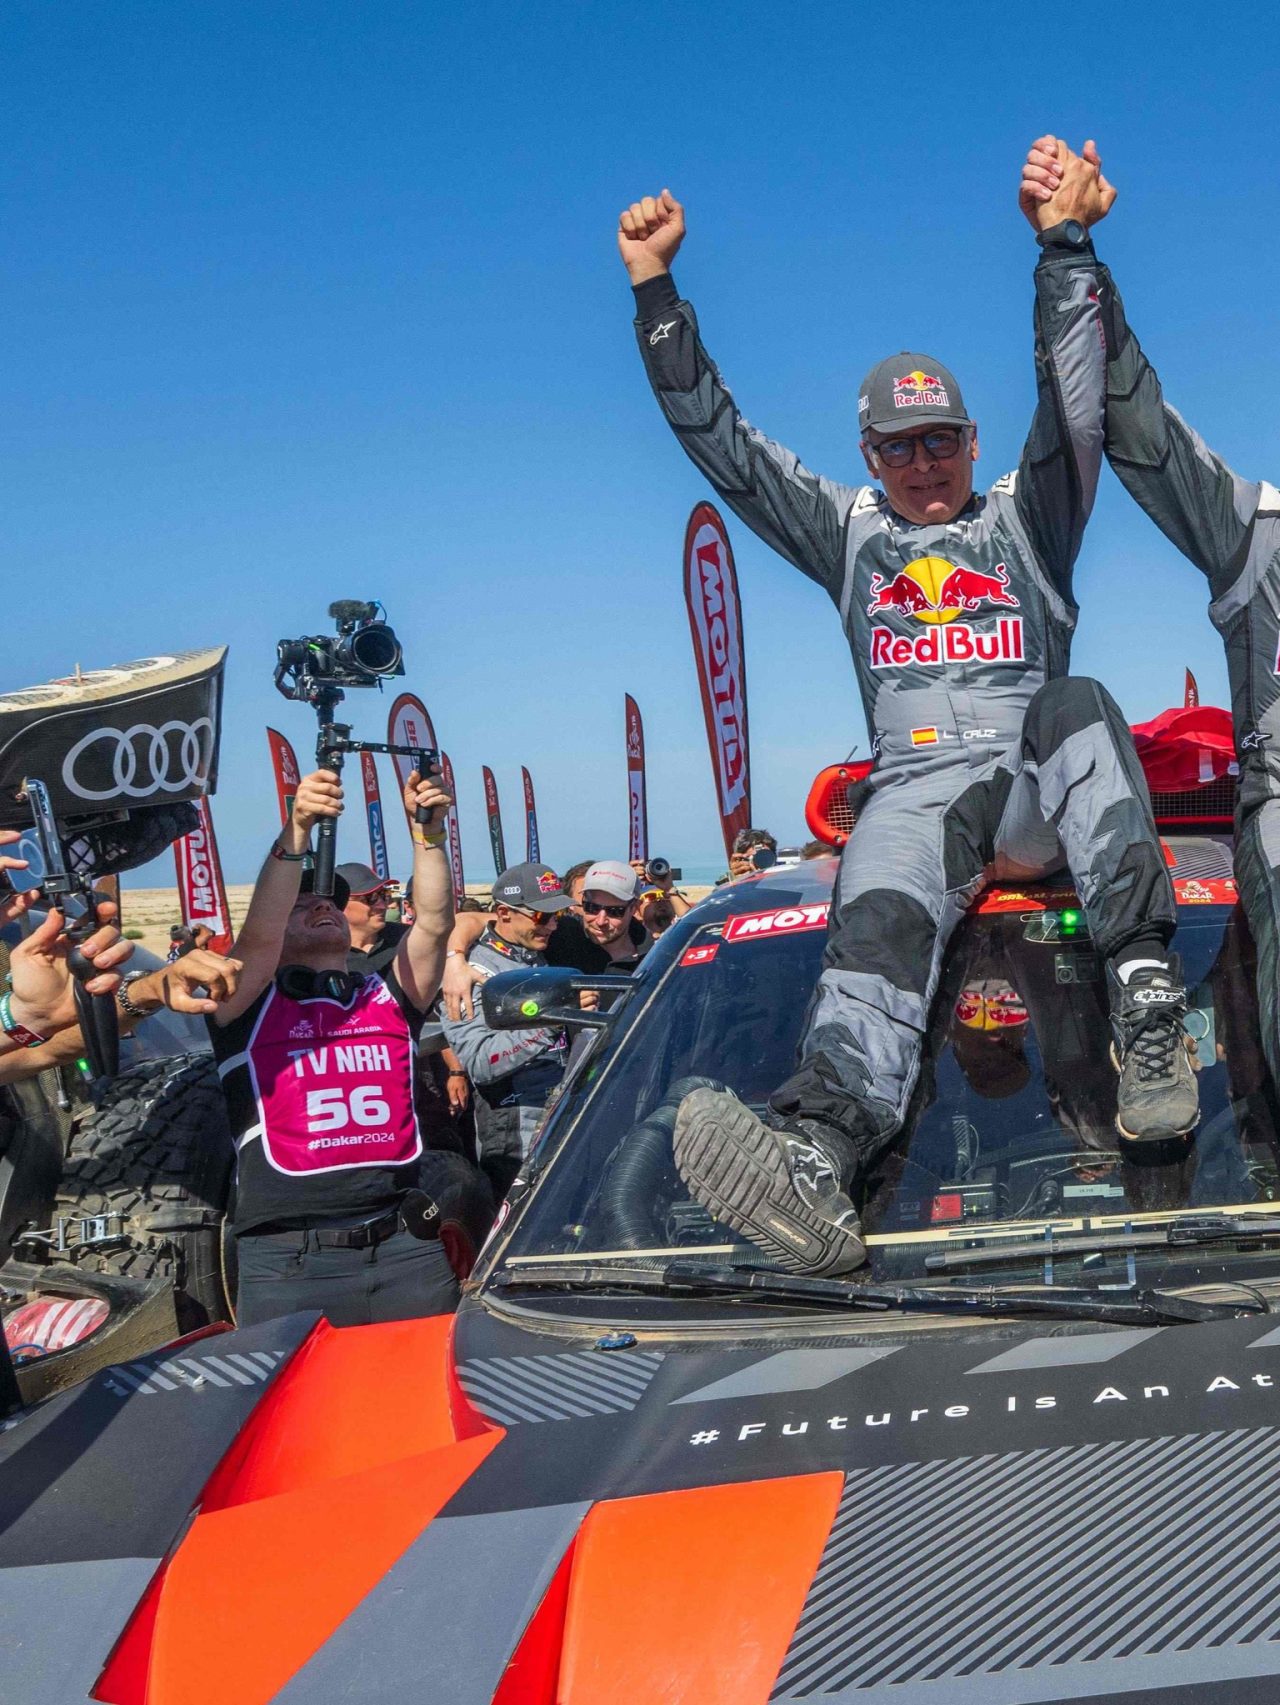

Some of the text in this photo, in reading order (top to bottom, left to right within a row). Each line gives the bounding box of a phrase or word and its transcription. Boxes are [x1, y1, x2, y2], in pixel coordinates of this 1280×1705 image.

[893, 391, 949, 408] Red Bull
[870, 617, 1025, 669] Red Bull
[700, 559, 739, 777] MOTUL
[943, 729, 997, 740] L CRUZ
[189, 822, 214, 913] MOTU
[735, 904, 832, 936] MOT
[287, 1044, 393, 1078] TV NRH
[305, 1085, 392, 1133] 56
[307, 1132, 396, 1152] #Dakar2024
[688, 1405, 971, 1446] #Future
[1007, 1396, 1057, 1412] Is
[1092, 1382, 1170, 1404] An
